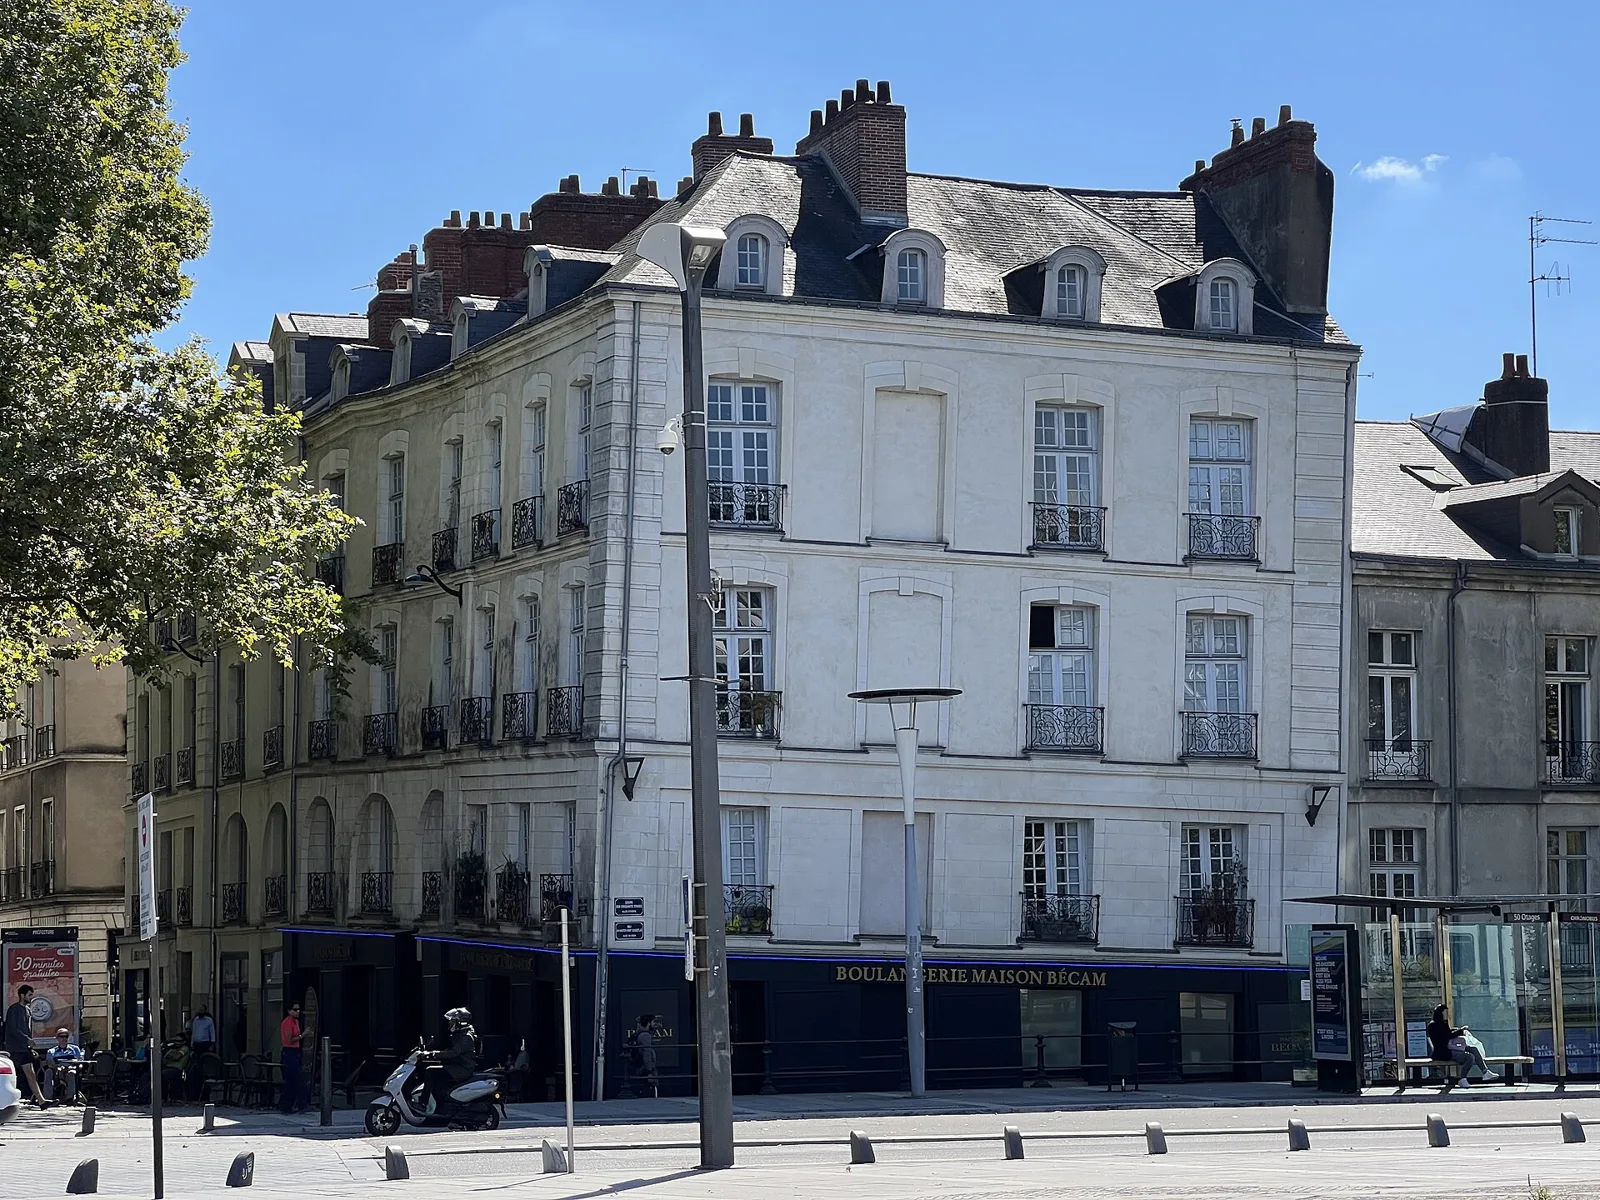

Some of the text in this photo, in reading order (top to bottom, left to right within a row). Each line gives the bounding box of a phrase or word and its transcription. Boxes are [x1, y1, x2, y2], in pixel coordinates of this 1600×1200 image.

[1513, 913, 1540, 922] 50 Otages
[13, 956, 32, 971] 30
[32, 959, 65, 969] minutes
[971, 968, 1042, 985] MAISON
[1047, 967, 1107, 987] BÉCAM
